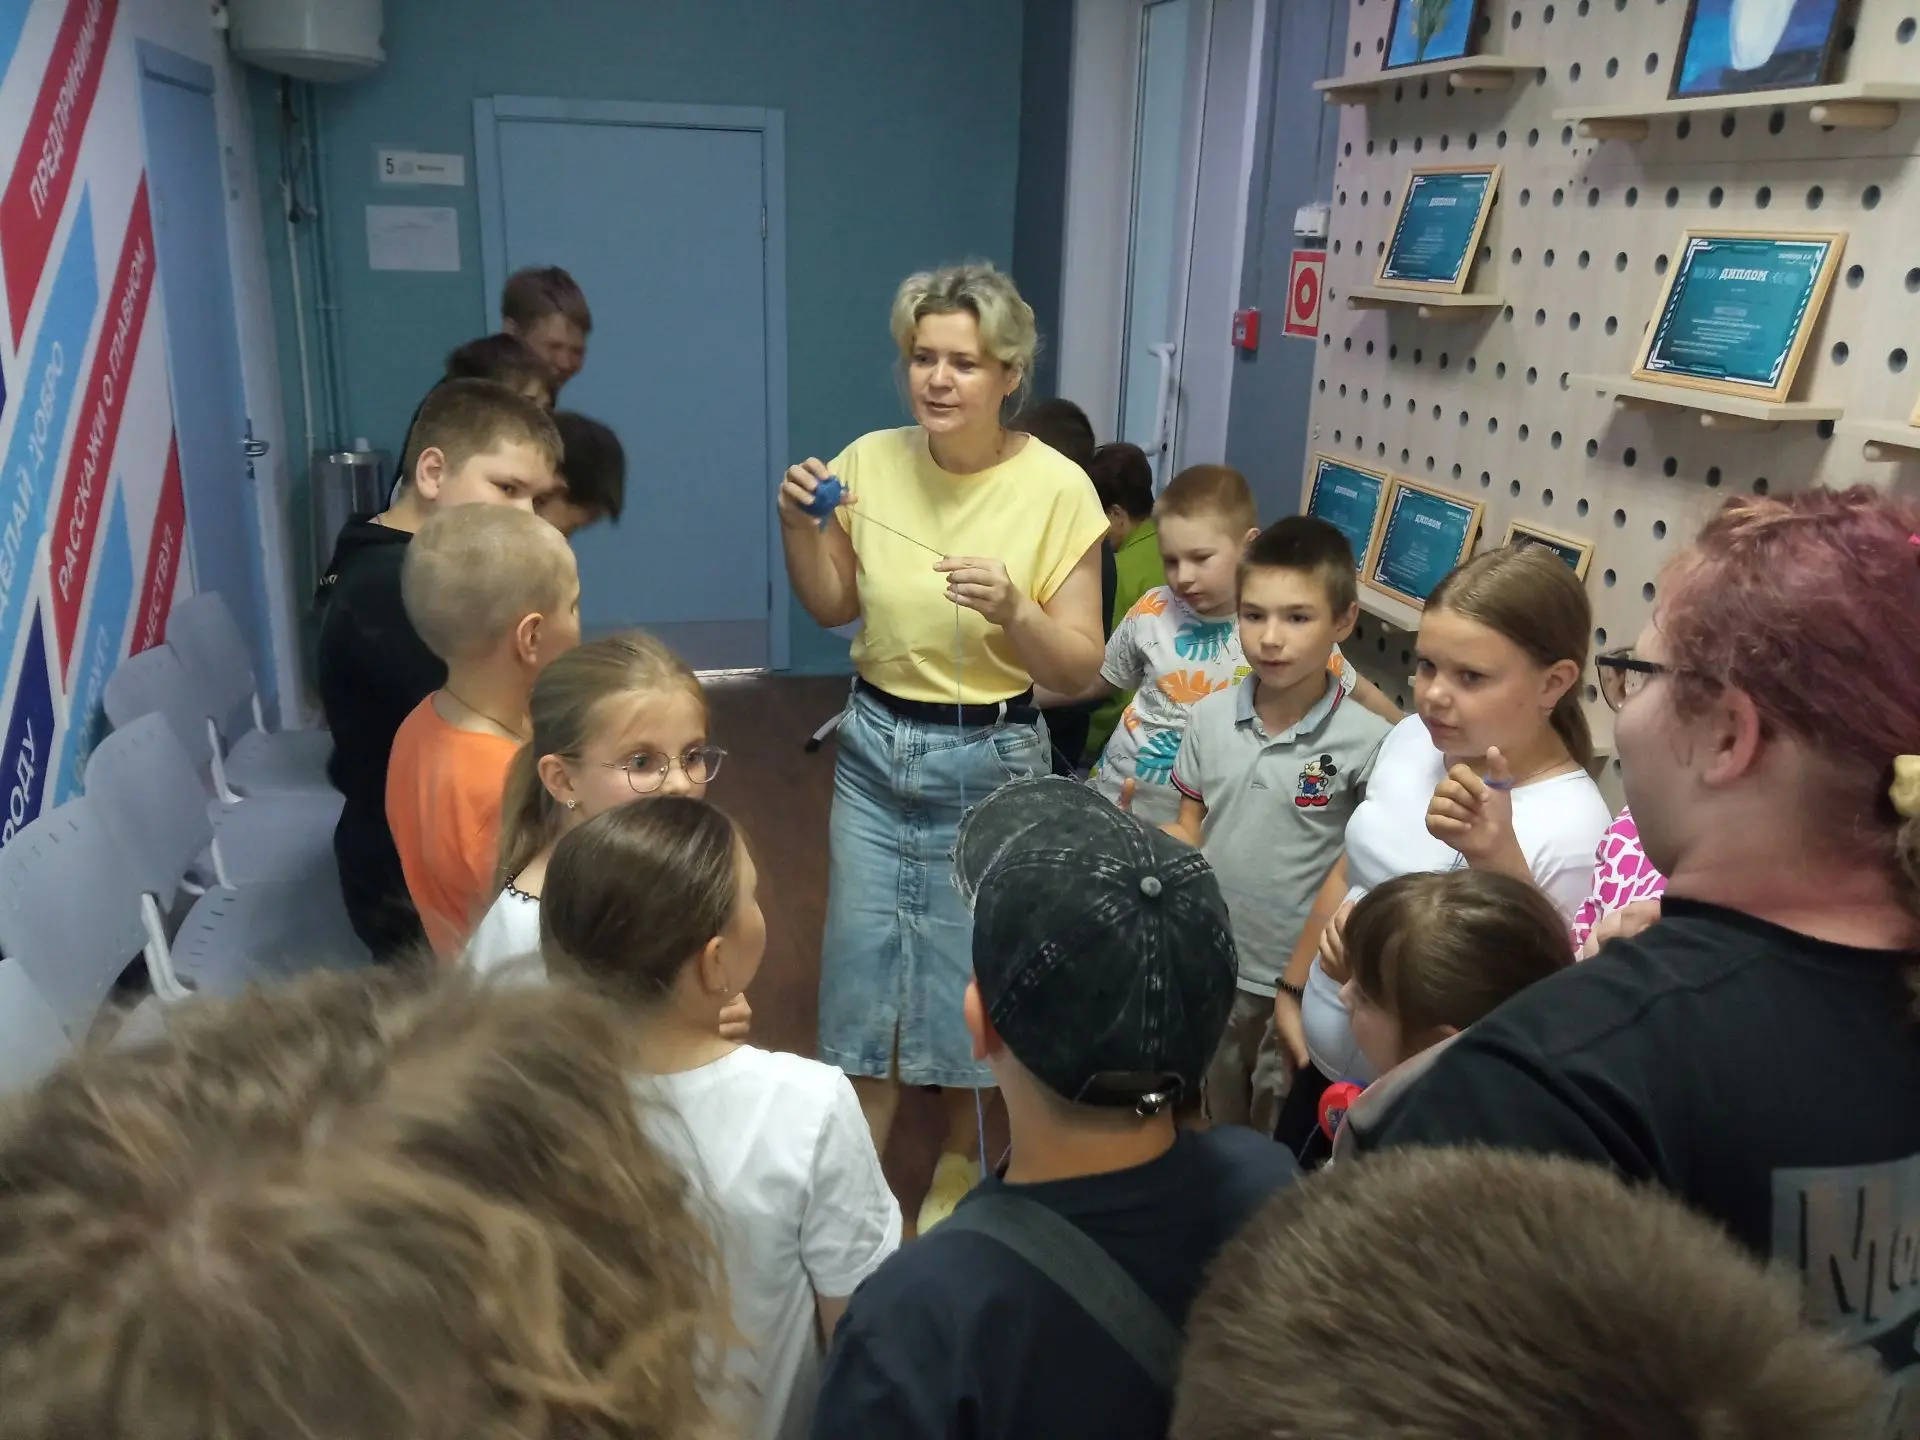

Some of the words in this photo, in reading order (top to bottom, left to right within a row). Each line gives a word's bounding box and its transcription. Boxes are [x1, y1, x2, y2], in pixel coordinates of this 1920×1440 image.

[385, 156, 395, 175] 5
[1718, 267, 1769, 282] ДИПЛОМ
[58, 400, 108, 603] РАССКАЖИ
[102, 373, 113, 407] О
[108, 236, 146, 380] ГЛАВНОМ
[0, 463, 33, 632] ЕЛАЙ
